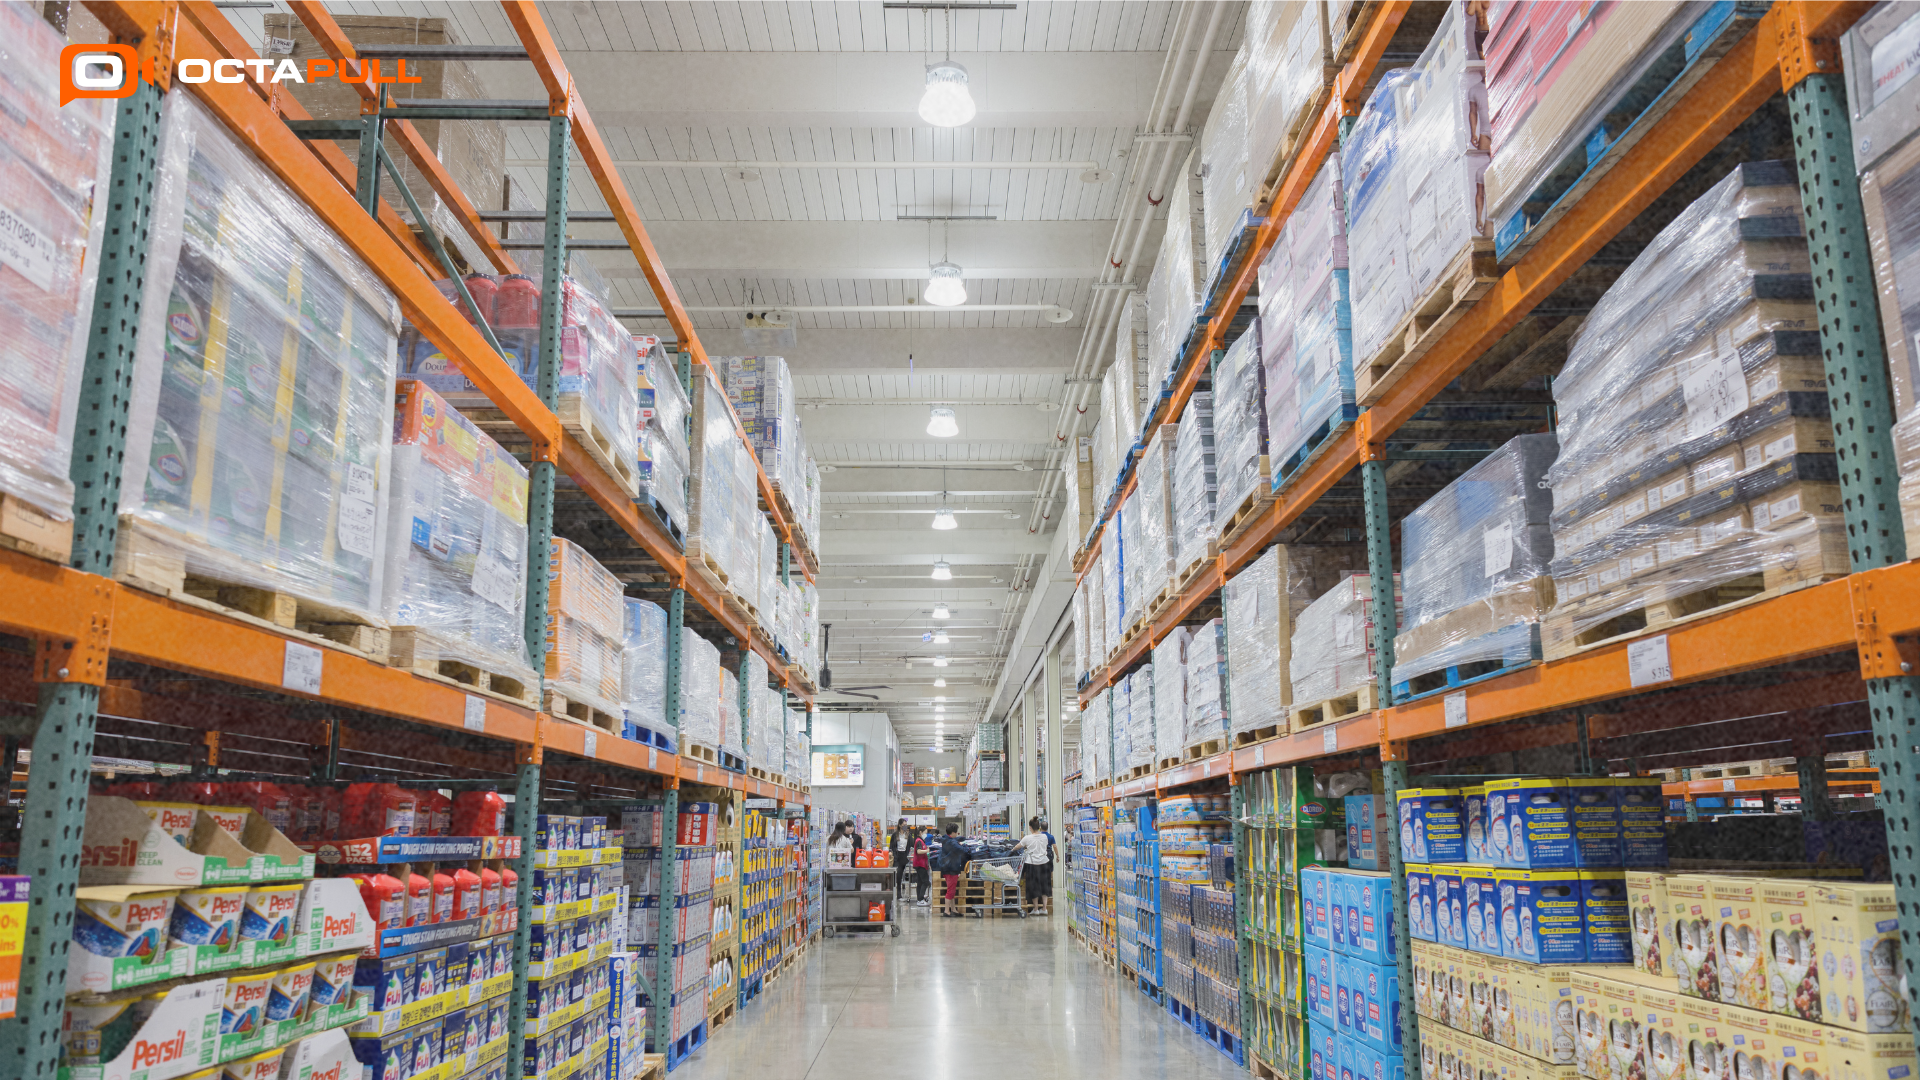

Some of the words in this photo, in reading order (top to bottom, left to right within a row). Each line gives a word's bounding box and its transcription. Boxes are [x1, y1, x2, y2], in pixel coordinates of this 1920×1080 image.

[161, 810, 192, 828] Persil
[80, 838, 138, 867] ersil
[137, 851, 158, 859] DEEP
[342, 843, 372, 856] 152
[401, 844, 419, 855] TOUGH
[419, 843, 435, 854] STAIN
[435, 843, 457, 854] FIGHTING
[457, 842, 473, 853] POWER
[346, 856, 373, 864] PACS
[15, 882, 30, 892] 168
[211, 896, 245, 914] Persil
[269, 892, 298, 911] Persil
[0, 914, 19, 929] 0%
[126, 901, 166, 924] Persil
[323, 912, 356, 938] Persil
[402, 933, 419, 946] TOUGH
[419, 931, 435, 943] STAIN
[435, 928, 456, 940] FIGHTING
[456, 925, 473, 937] POWER
[0, 940, 16, 951] ins
[234, 980, 268, 1002] Persil
[1870, 1000, 1895, 1008] FLAIR
[131, 1029, 186, 1071] Persil
